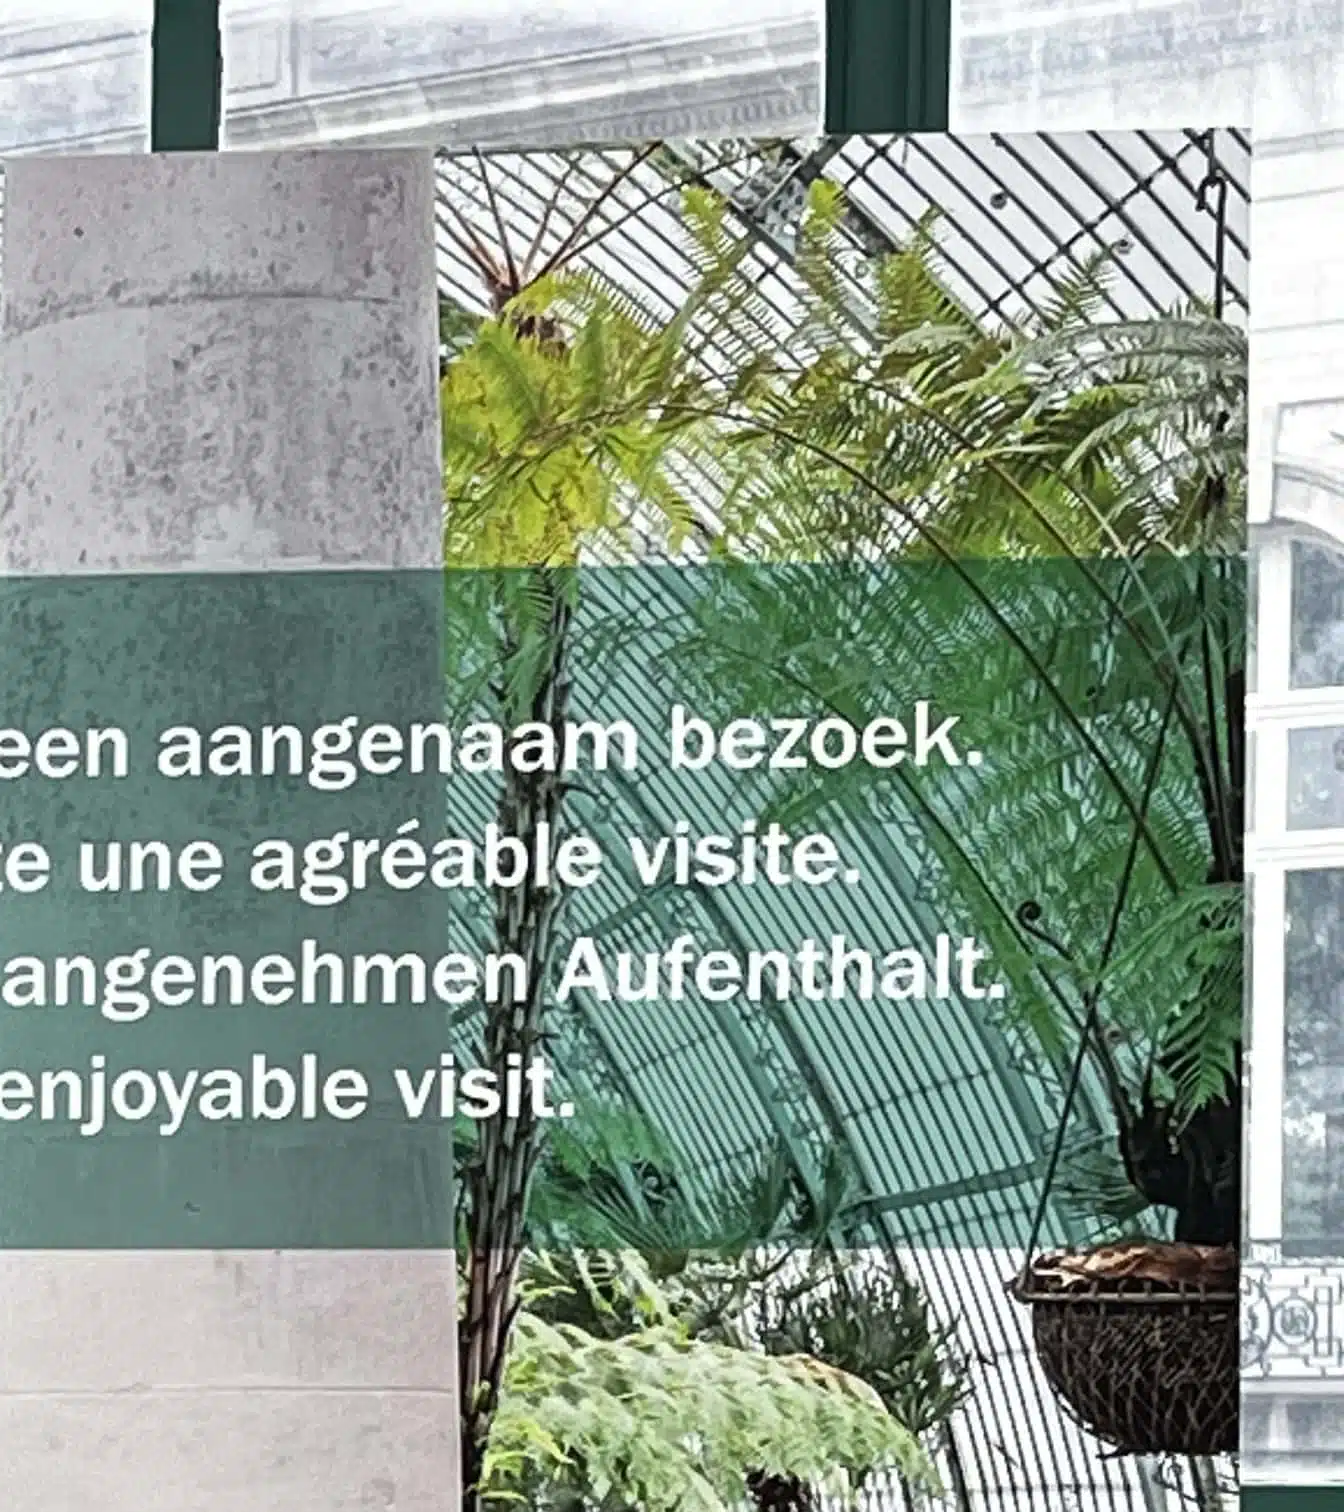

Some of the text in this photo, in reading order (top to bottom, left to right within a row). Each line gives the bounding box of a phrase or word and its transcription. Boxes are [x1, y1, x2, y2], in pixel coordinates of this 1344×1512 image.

[158, 716, 638, 790] aangenaam
[670, 700, 983, 770] bezoek.
[80, 841, 223, 892] une
[250, 818, 602, 906] agréable
[628, 819, 860, 887] visite.
[2, 939, 527, 1021] angenehmen
[555, 933, 1004, 1002] Aufenthalt.
[394, 1053, 575, 1118] visit.
